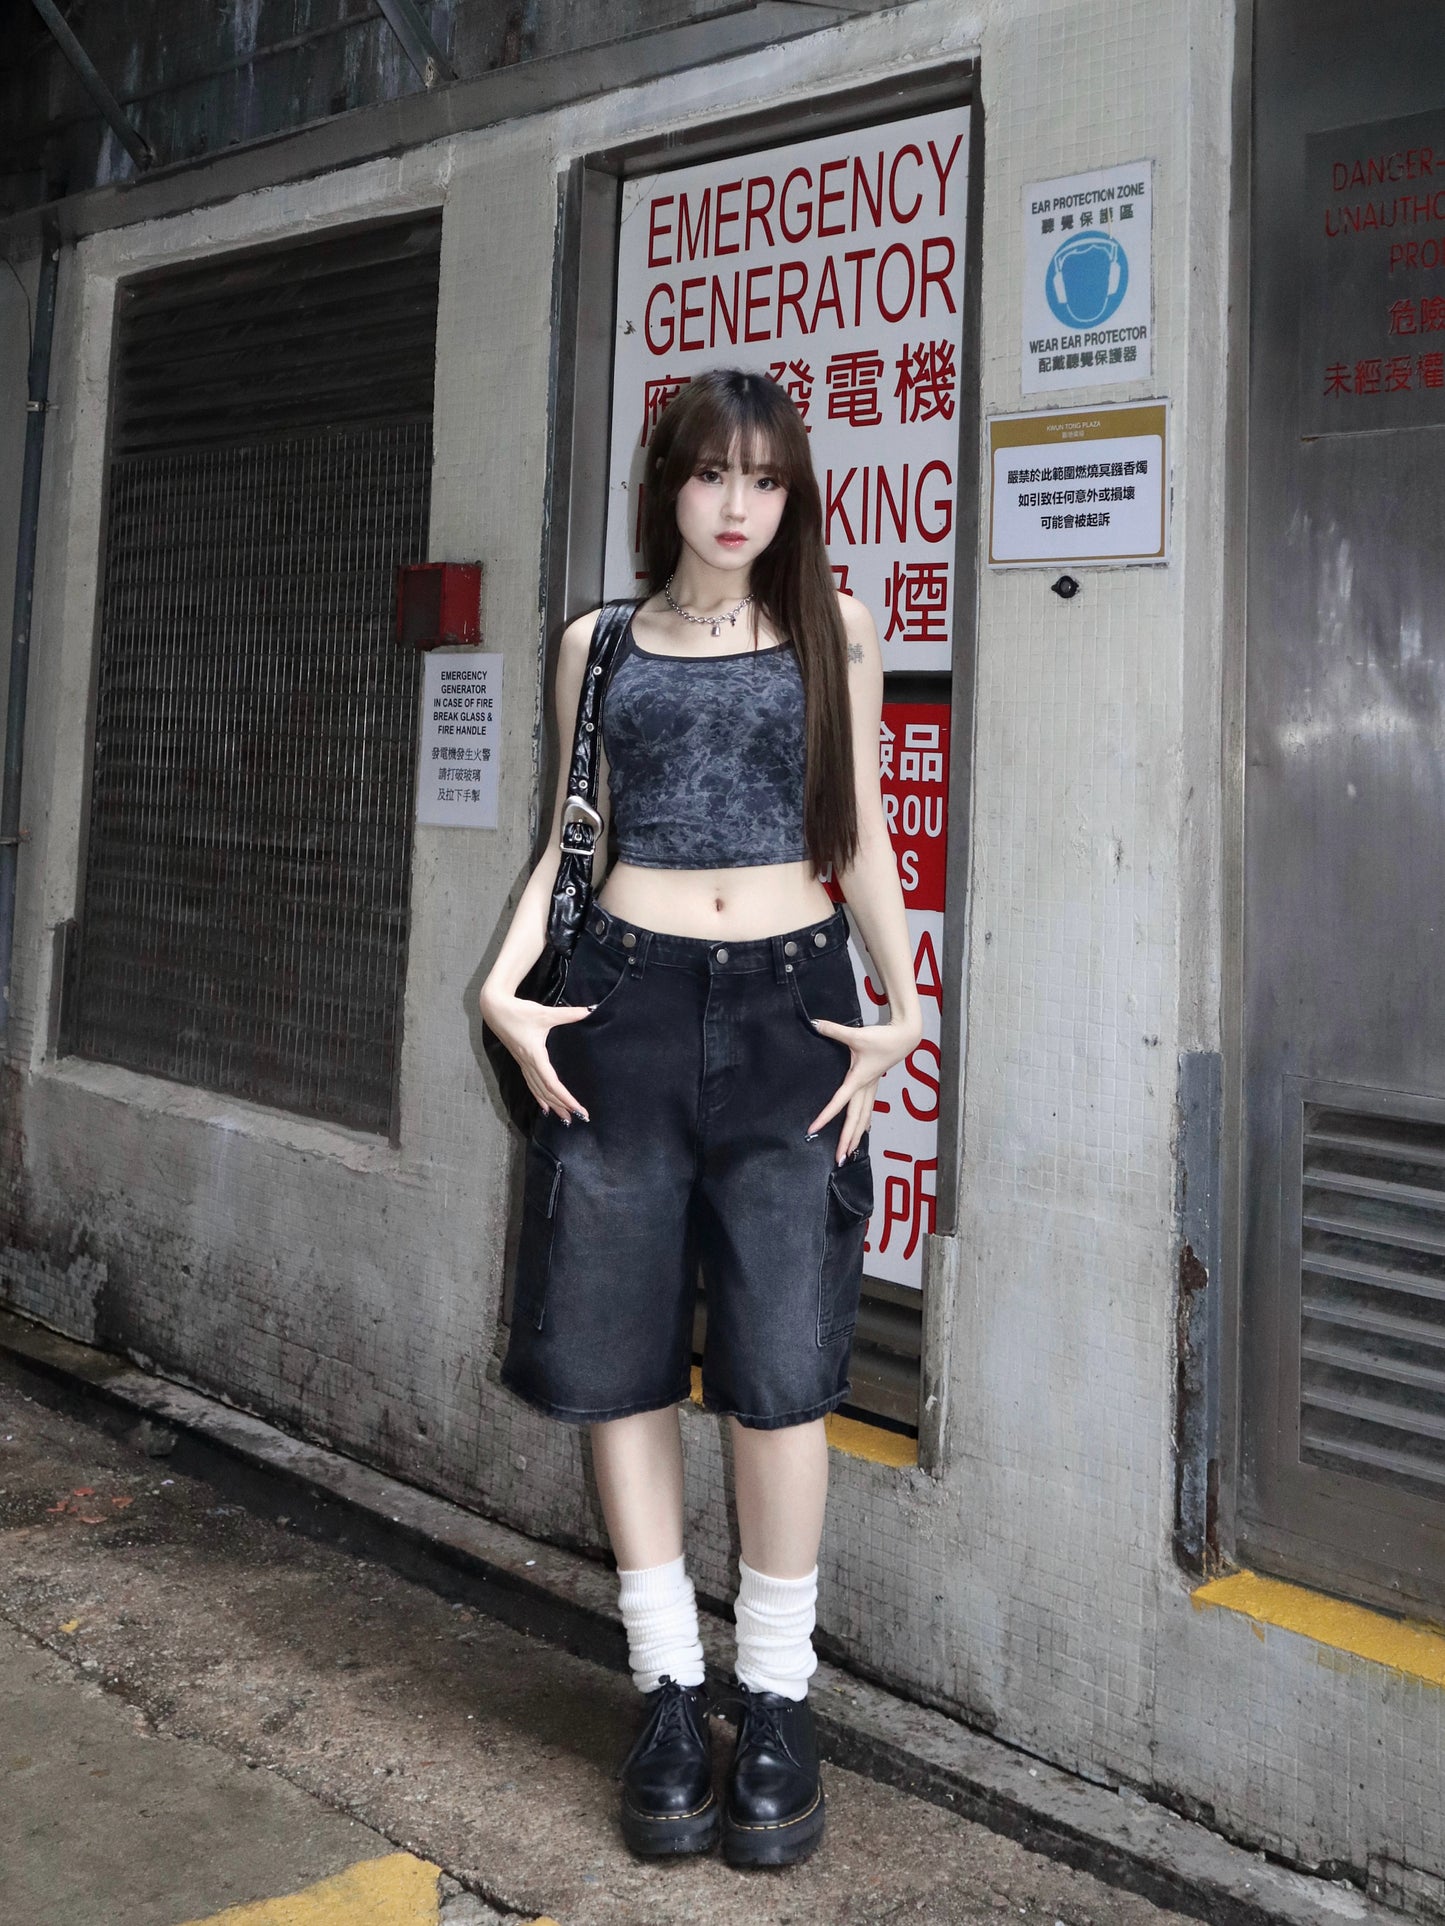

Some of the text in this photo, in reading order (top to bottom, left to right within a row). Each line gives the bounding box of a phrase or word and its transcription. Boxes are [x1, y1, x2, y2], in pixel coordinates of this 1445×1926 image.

[648, 134, 964, 269] EMERGENCY
[1032, 182, 1145, 215] EAR PROTECTION ZONE
[1041, 203, 1134, 235] 聽覺保護區
[644, 236, 957, 356] GENERATOR
[1030, 325, 1147, 354] WEAR EAR PROTECTOR
[1038, 345, 1137, 374] 配戴聽覺保護器
[1065, 422, 1081, 430] TONG
[1082, 420, 1101, 429] PLAZA
[824, 459, 953, 546] KING
[1018, 485, 1135, 508] 如引致任何意外或損壞
[1040, 512, 1110, 530] 可能會被起訴
[441, 671, 487, 681] EMERGENCY
[441, 684, 486, 694] GENERATOR
[434, 699, 493, 708] IN CASE OF FIRE
[433, 712, 493, 722] BREAK GLASS &
[438, 725, 486, 736] FIRE HANDLE
[431, 746, 491, 762] 發電機發生火警
[438, 767, 481, 782] 請打破玻璃
